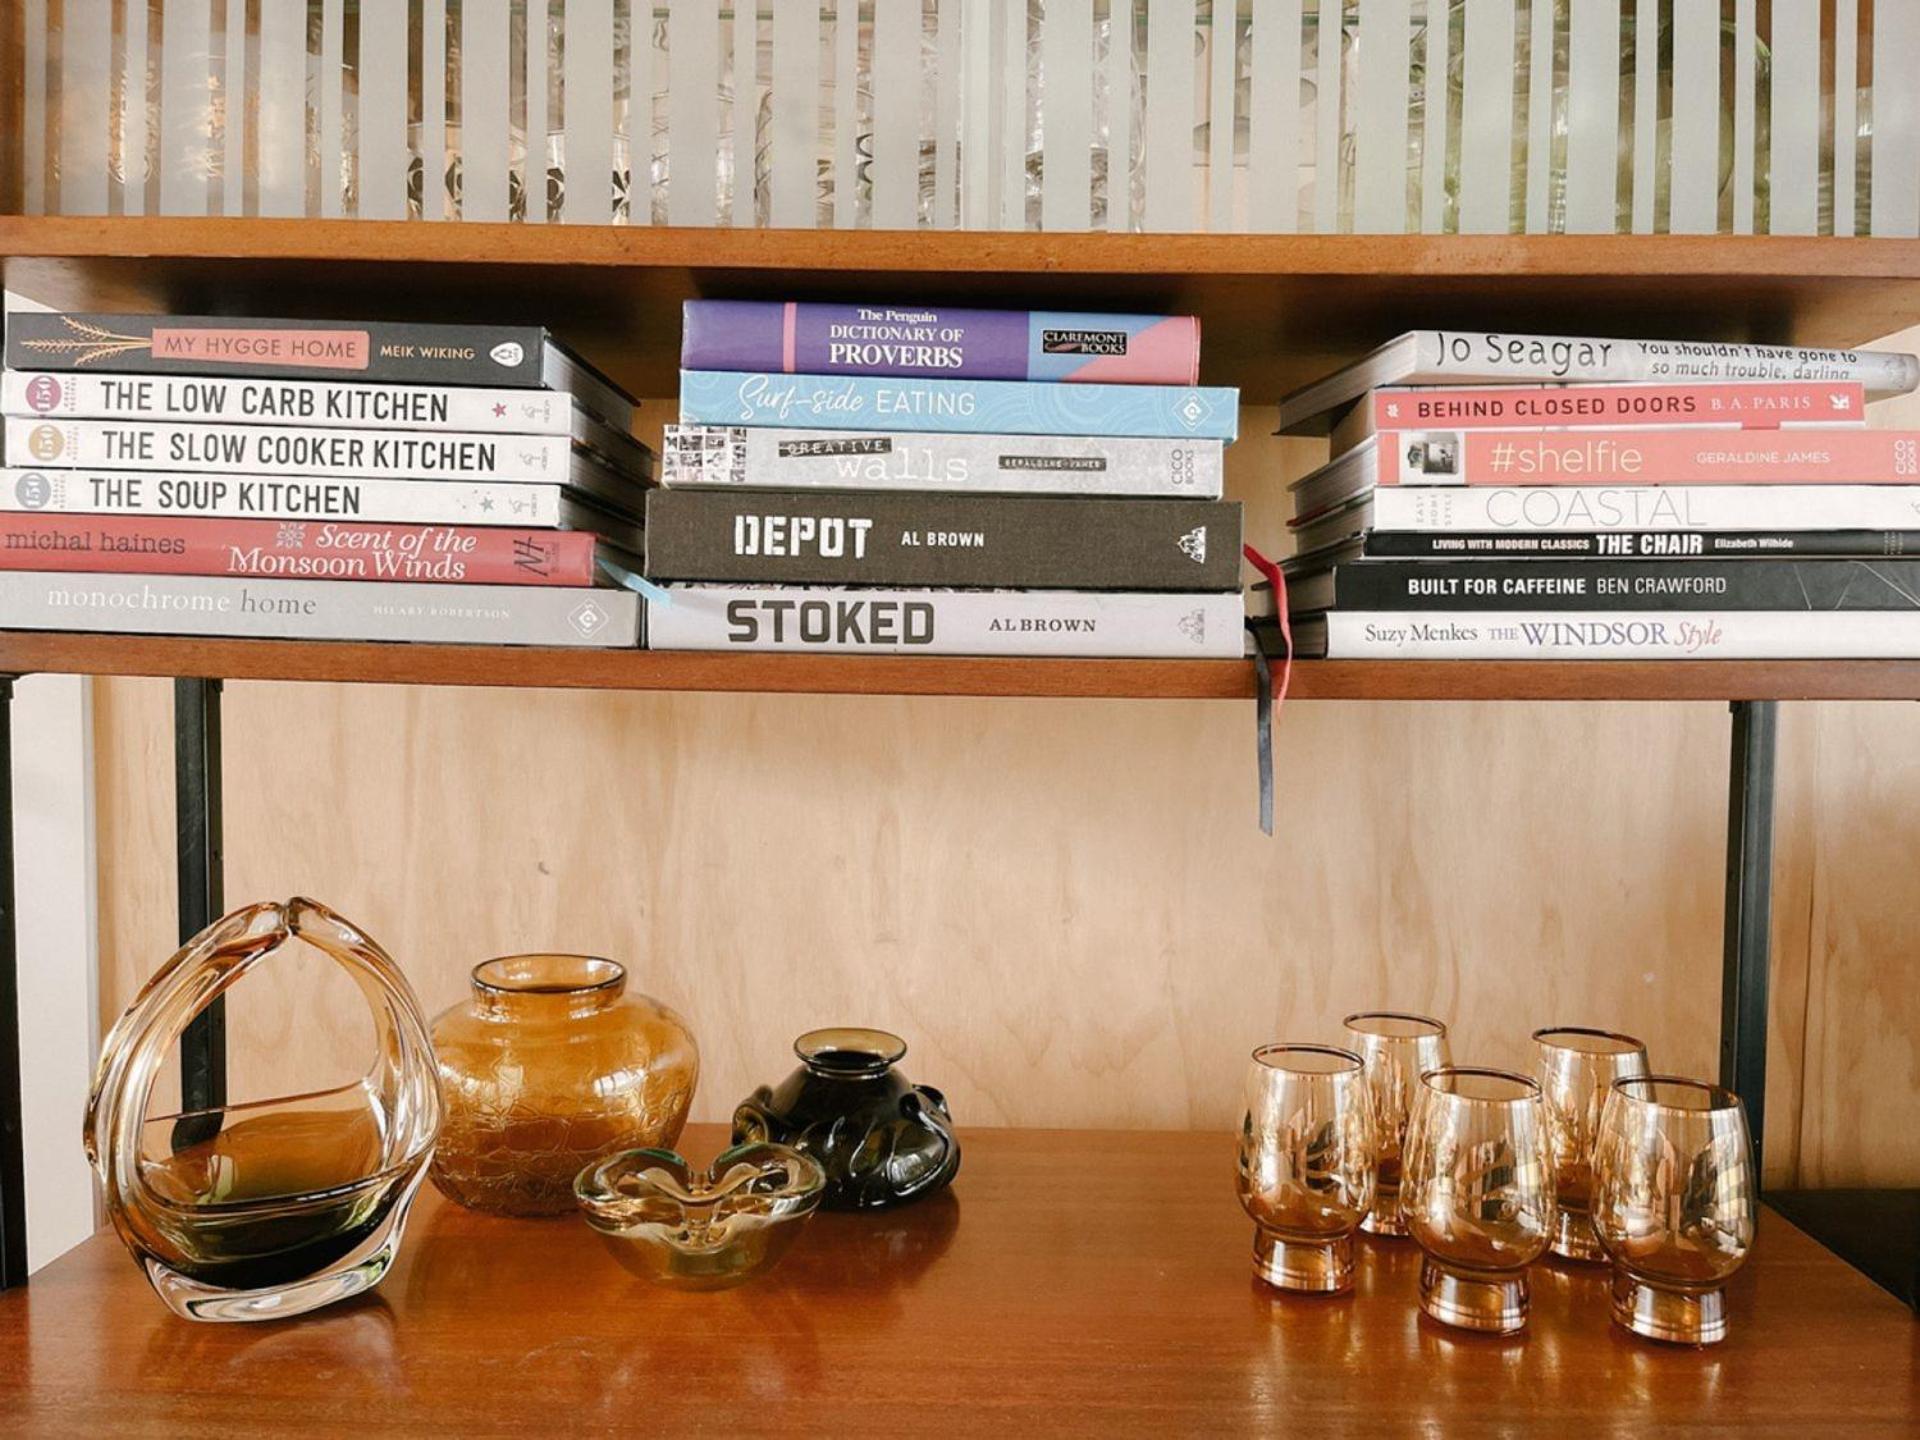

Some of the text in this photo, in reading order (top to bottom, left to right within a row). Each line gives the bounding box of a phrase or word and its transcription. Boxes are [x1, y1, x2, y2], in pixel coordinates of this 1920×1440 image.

[857, 308, 937, 324] The Penguin
[830, 324, 964, 342] DICTIONARY OF
[1044, 331, 1125, 344] CLAREMONT
[165, 337, 356, 358] MY HYGGE HOME
[380, 345, 475, 360] MEIK WIKING
[829, 344, 963, 368] PROVERBS
[1081, 343, 1125, 354] BOOKS
[1437, 333, 1612, 376] Jo Seagar
[1638, 342, 1857, 364] You shouldn't have gone to
[1652, 362, 1669, 374] so
[1676, 362, 1719, 377] much
[1793, 365, 1849, 380] darling
[101, 381, 448, 422] THE LOW CARB KITCHEN
[739, 374, 975, 420] Surf-side EATING
[1418, 396, 1696, 418] BEHIND CLOSED DOORS
[1753, 396, 1812, 410] PARIS
[102, 430, 495, 471] THE SLOW COOKER KITCHEN
[788, 440, 884, 455] CREATIVE
[1489, 440, 1642, 473] #shelfie
[1697, 452, 1830, 464] GERALDINE JAMES
[1894, 440, 1906, 474] CICO
[835, 447, 968, 482] walls
[1171, 449, 1183, 485] CICO
[1184, 449, 1194, 485] BOOKS
[90, 478, 360, 514] THE SOUP KITCHEN
[1487, 489, 1707, 527] COASTAL
[5, 530, 186, 555] michal haines
[316, 524, 477, 559] Scent of the
[735, 515, 873, 559] DEPOT
[901, 532, 984, 546] AL BROWN
[1432, 534, 1794, 555] LIVING WITH MODERN CLASSICS THE CHAIR Elizabeth Wilhide
[227, 546, 465, 580] Monsoon Winds
[1408, 577, 1727, 595] BUILT FOR CAFFEINE BEN CRAWFORD
[48, 585, 317, 615] monochrome home
[373, 604, 511, 619] HILARY ROBERTSON
[727, 600, 934, 645] STOKED
[1365, 619, 1723, 653] Suzy Menkes THE WINDSOR Style
